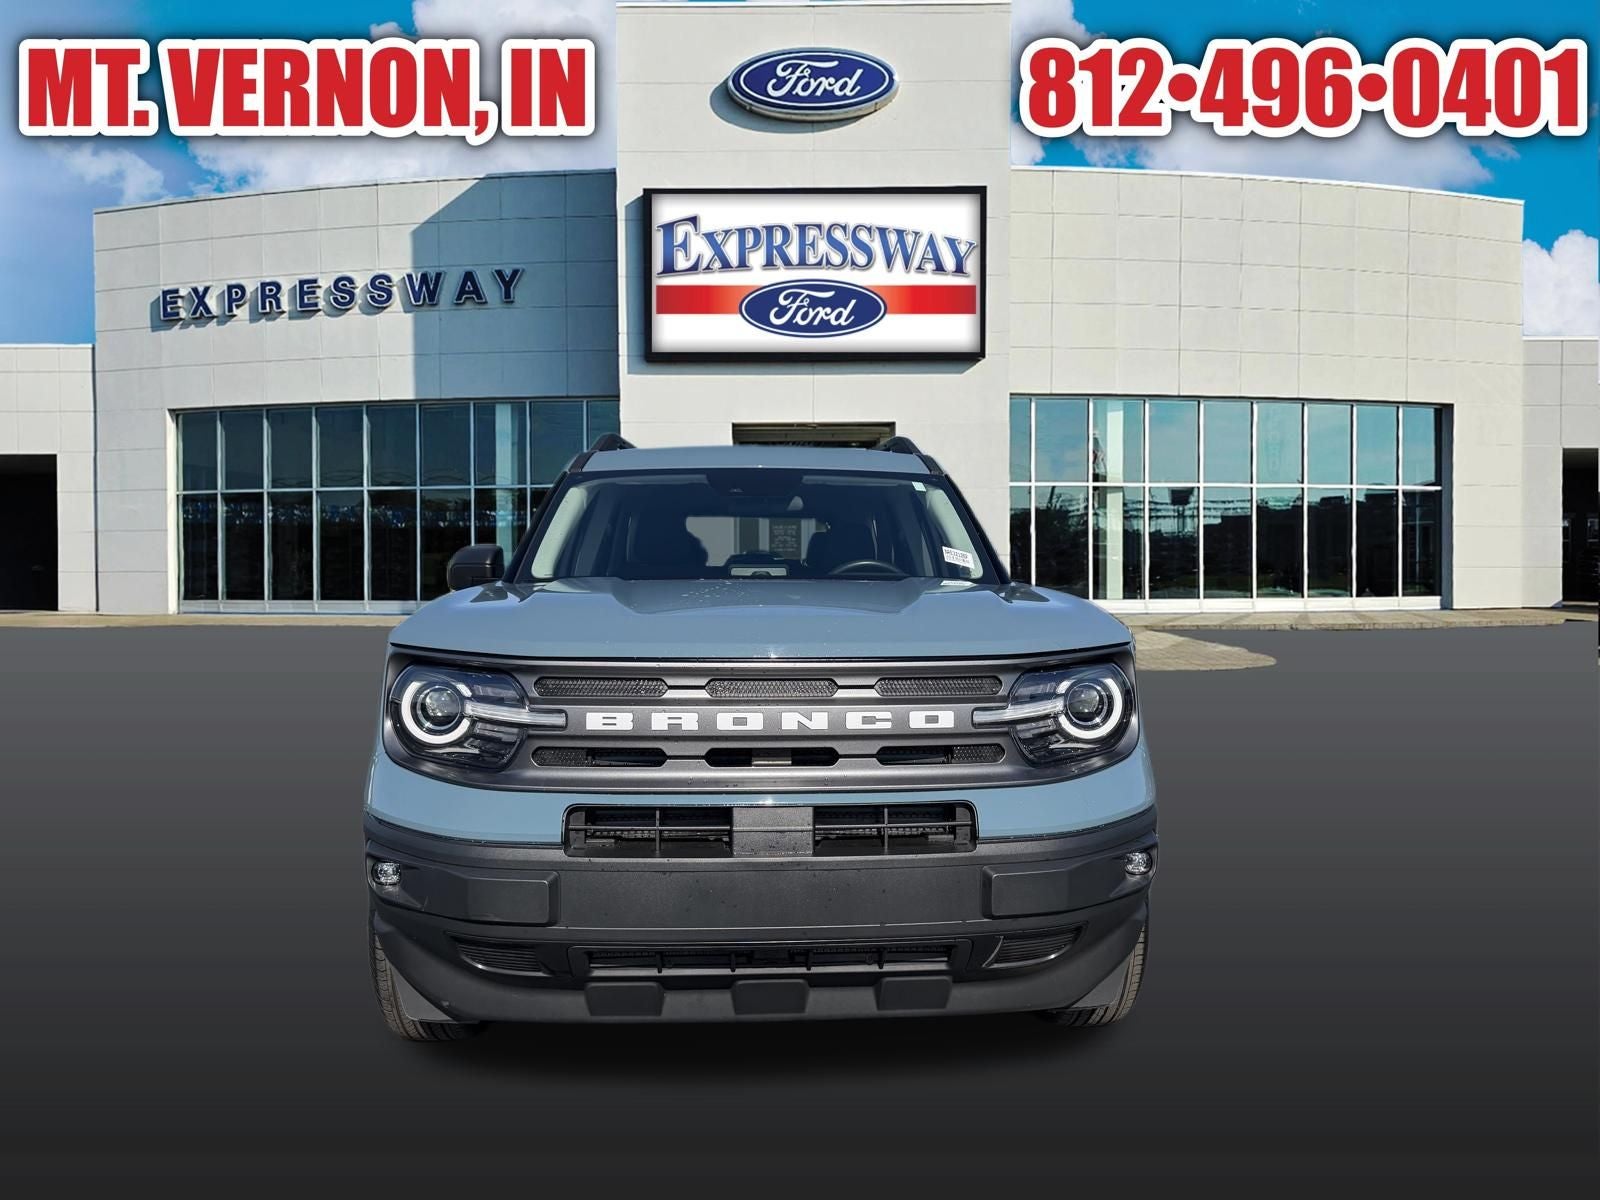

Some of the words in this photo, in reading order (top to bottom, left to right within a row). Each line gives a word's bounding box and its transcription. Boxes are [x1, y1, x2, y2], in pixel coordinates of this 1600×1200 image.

[766, 59, 864, 98] Ford
[656, 214, 977, 277] EXPRESSWAY
[159, 268, 525, 322] EXPRESSWAY
[769, 288, 855, 327] Ford
[585, 710, 955, 732] BRONCO
